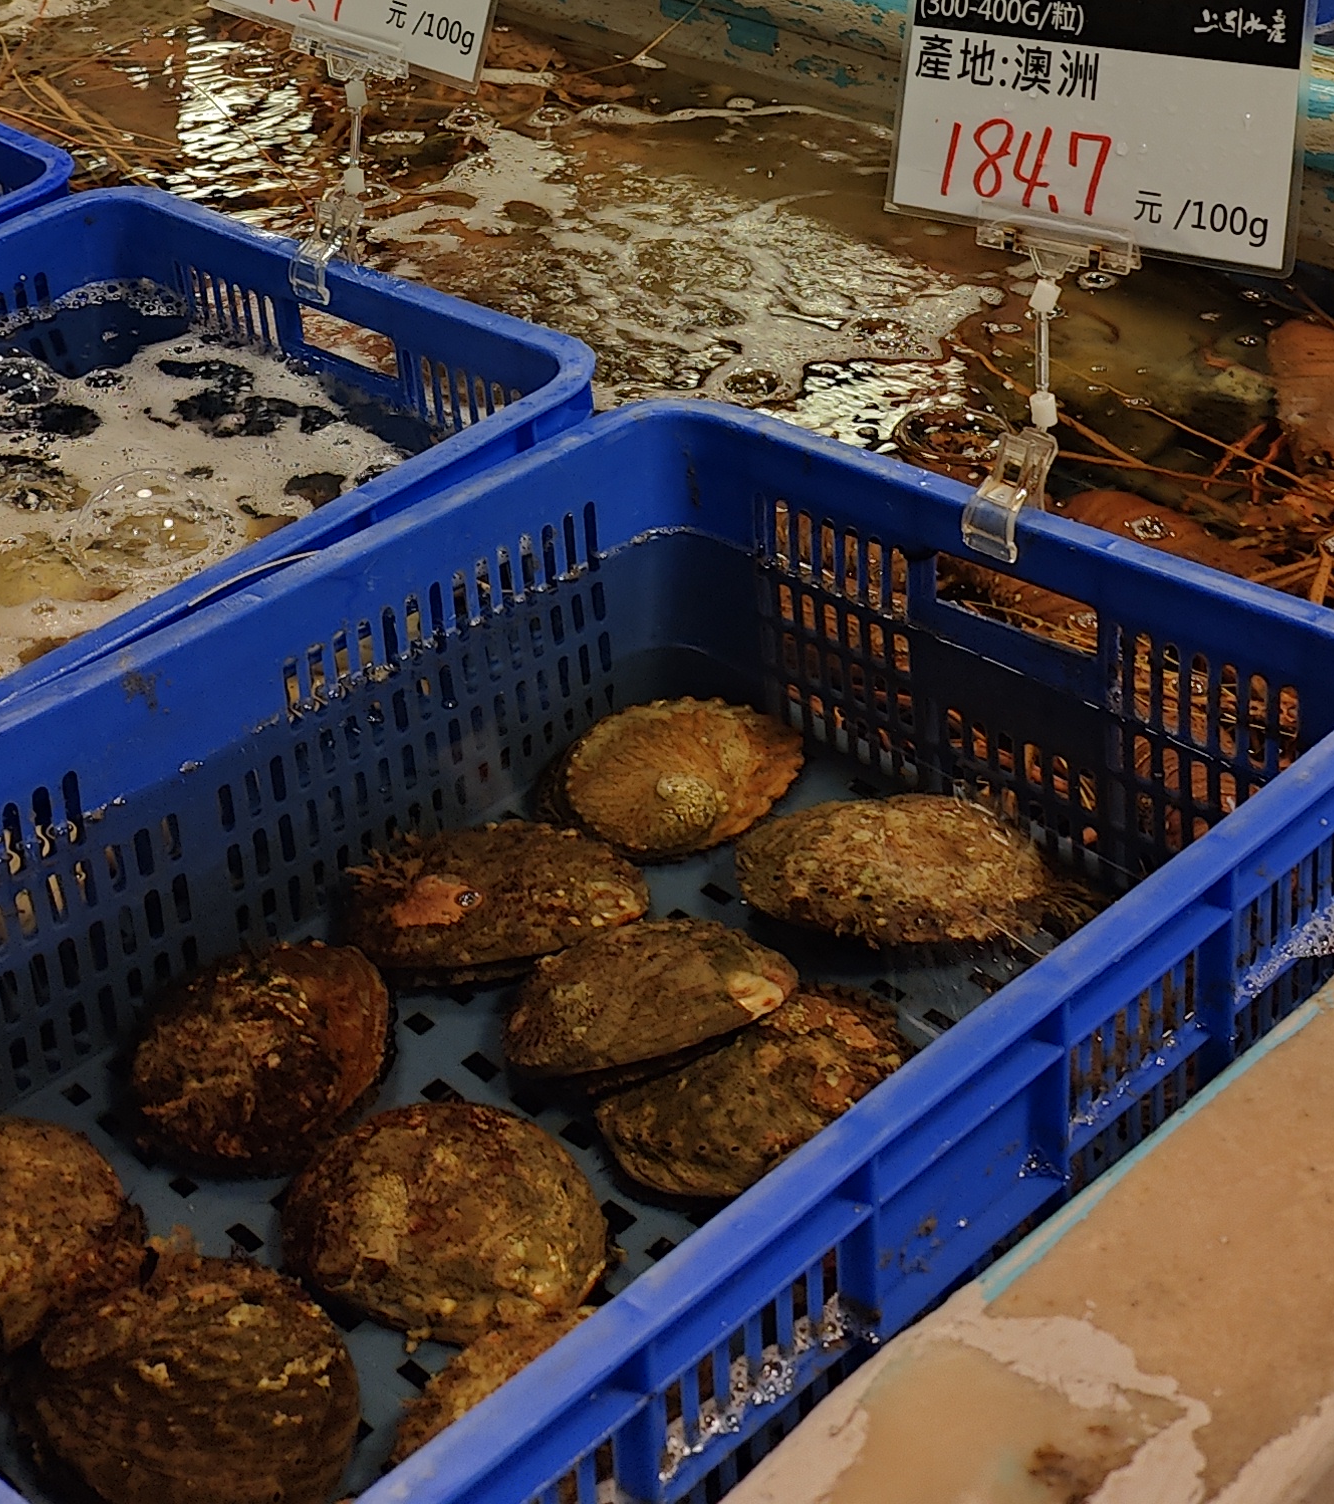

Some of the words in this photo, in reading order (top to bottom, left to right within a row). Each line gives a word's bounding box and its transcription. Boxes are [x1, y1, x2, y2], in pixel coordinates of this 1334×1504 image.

[385, 0, 408, 29] 元
[411, 10, 475, 55] /100g
[915, 34, 1100, 101] 產地:澳洲
[1133, 190, 1163, 225] 元
[1173, 198, 1269, 248] /100g
